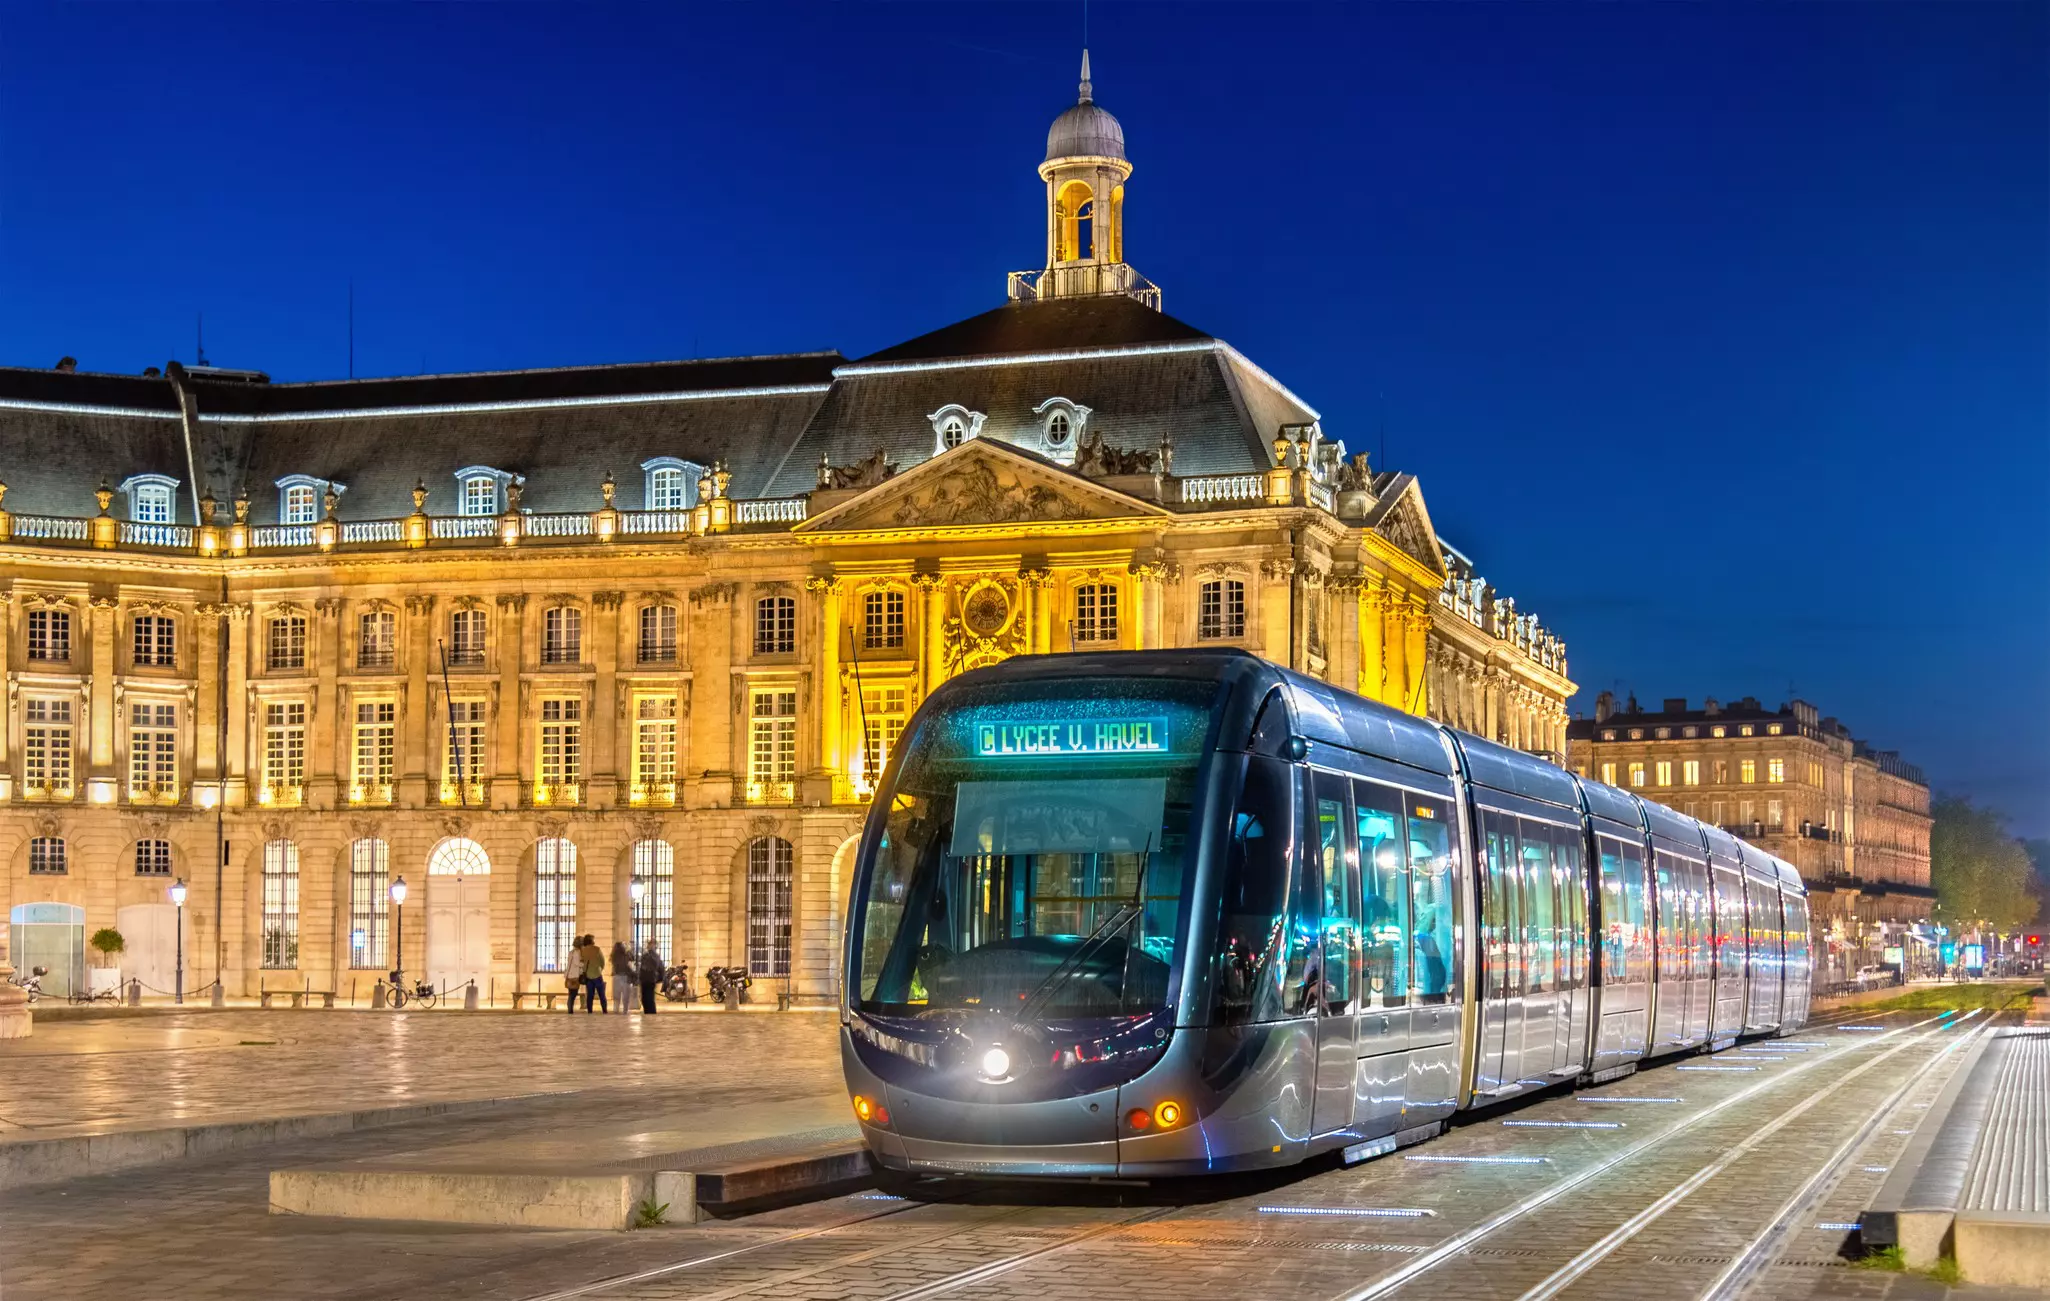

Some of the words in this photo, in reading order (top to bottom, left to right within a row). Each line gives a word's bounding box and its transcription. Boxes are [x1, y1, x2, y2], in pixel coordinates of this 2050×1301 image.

[1002, 725, 1061, 753] LYCEE
[1069, 724, 1087, 751] V.
[1096, 722, 1159, 750] HAVEL
